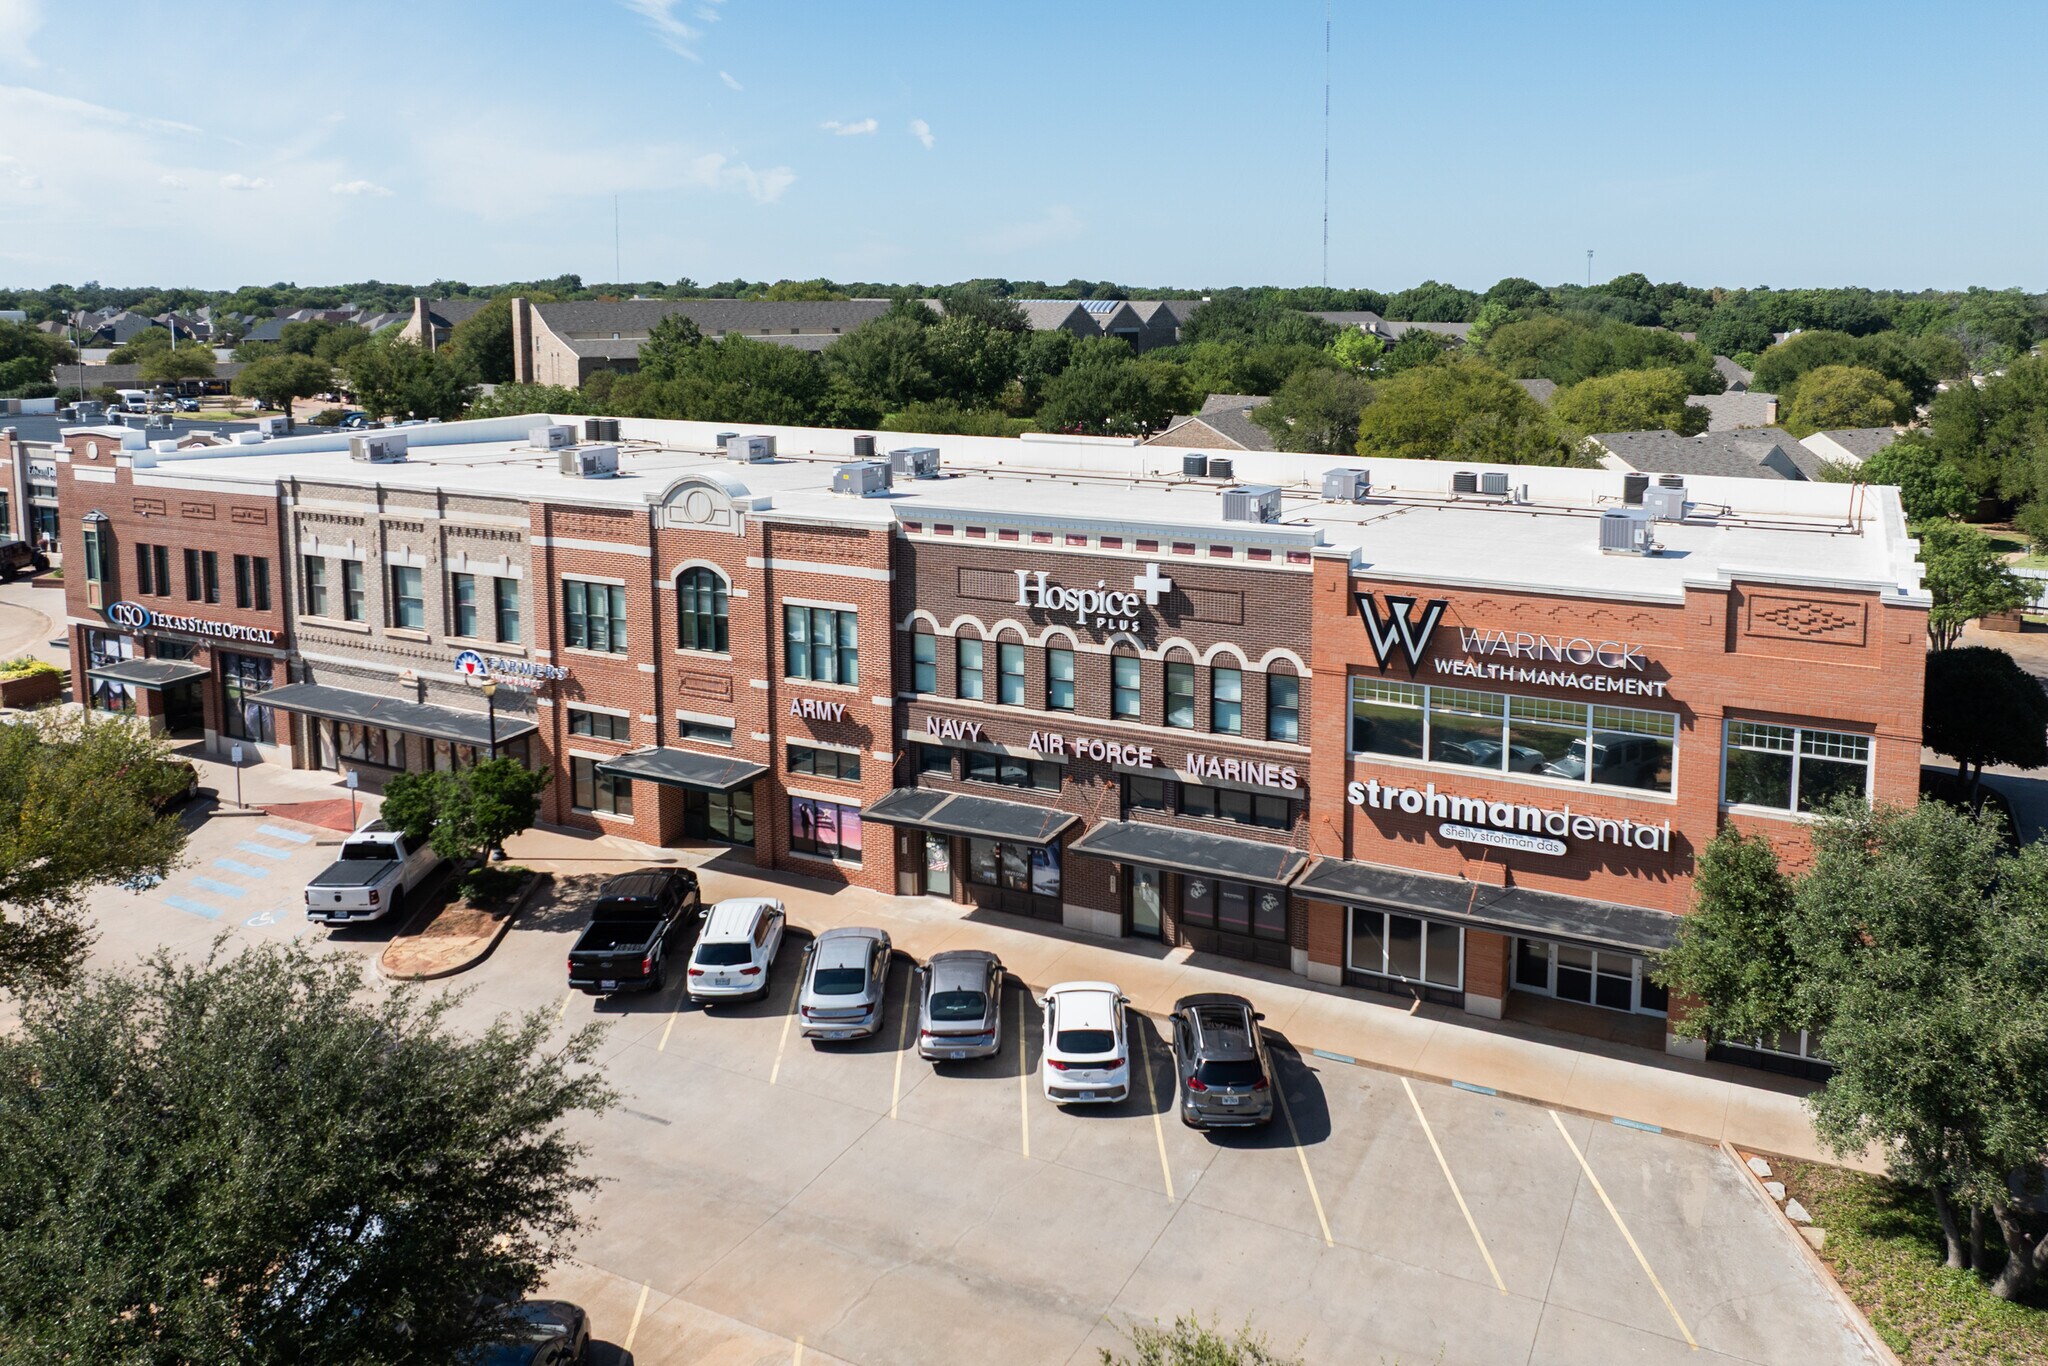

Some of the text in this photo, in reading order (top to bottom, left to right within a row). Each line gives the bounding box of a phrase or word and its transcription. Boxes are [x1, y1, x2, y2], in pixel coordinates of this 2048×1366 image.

[1014, 569, 1140, 625] Hospice
[116, 604, 143, 627] TSO
[151, 611, 275, 644] TEXAS STATE OPTICAL
[1096, 617, 1140, 633] PLUS
[1459, 626, 1645, 673] WARNOCK
[488, 656, 569, 681] FARMERS
[1433, 657, 1668, 698] WEALTH MANAGEMENT
[790, 697, 847, 723] ARMY
[927, 715, 983, 743] NAVY
[1027, 730, 1154, 769] AIR FORCE
[1186, 752, 1298, 791] MARINES
[1445, 825, 1560, 853] shelly strohman dds
